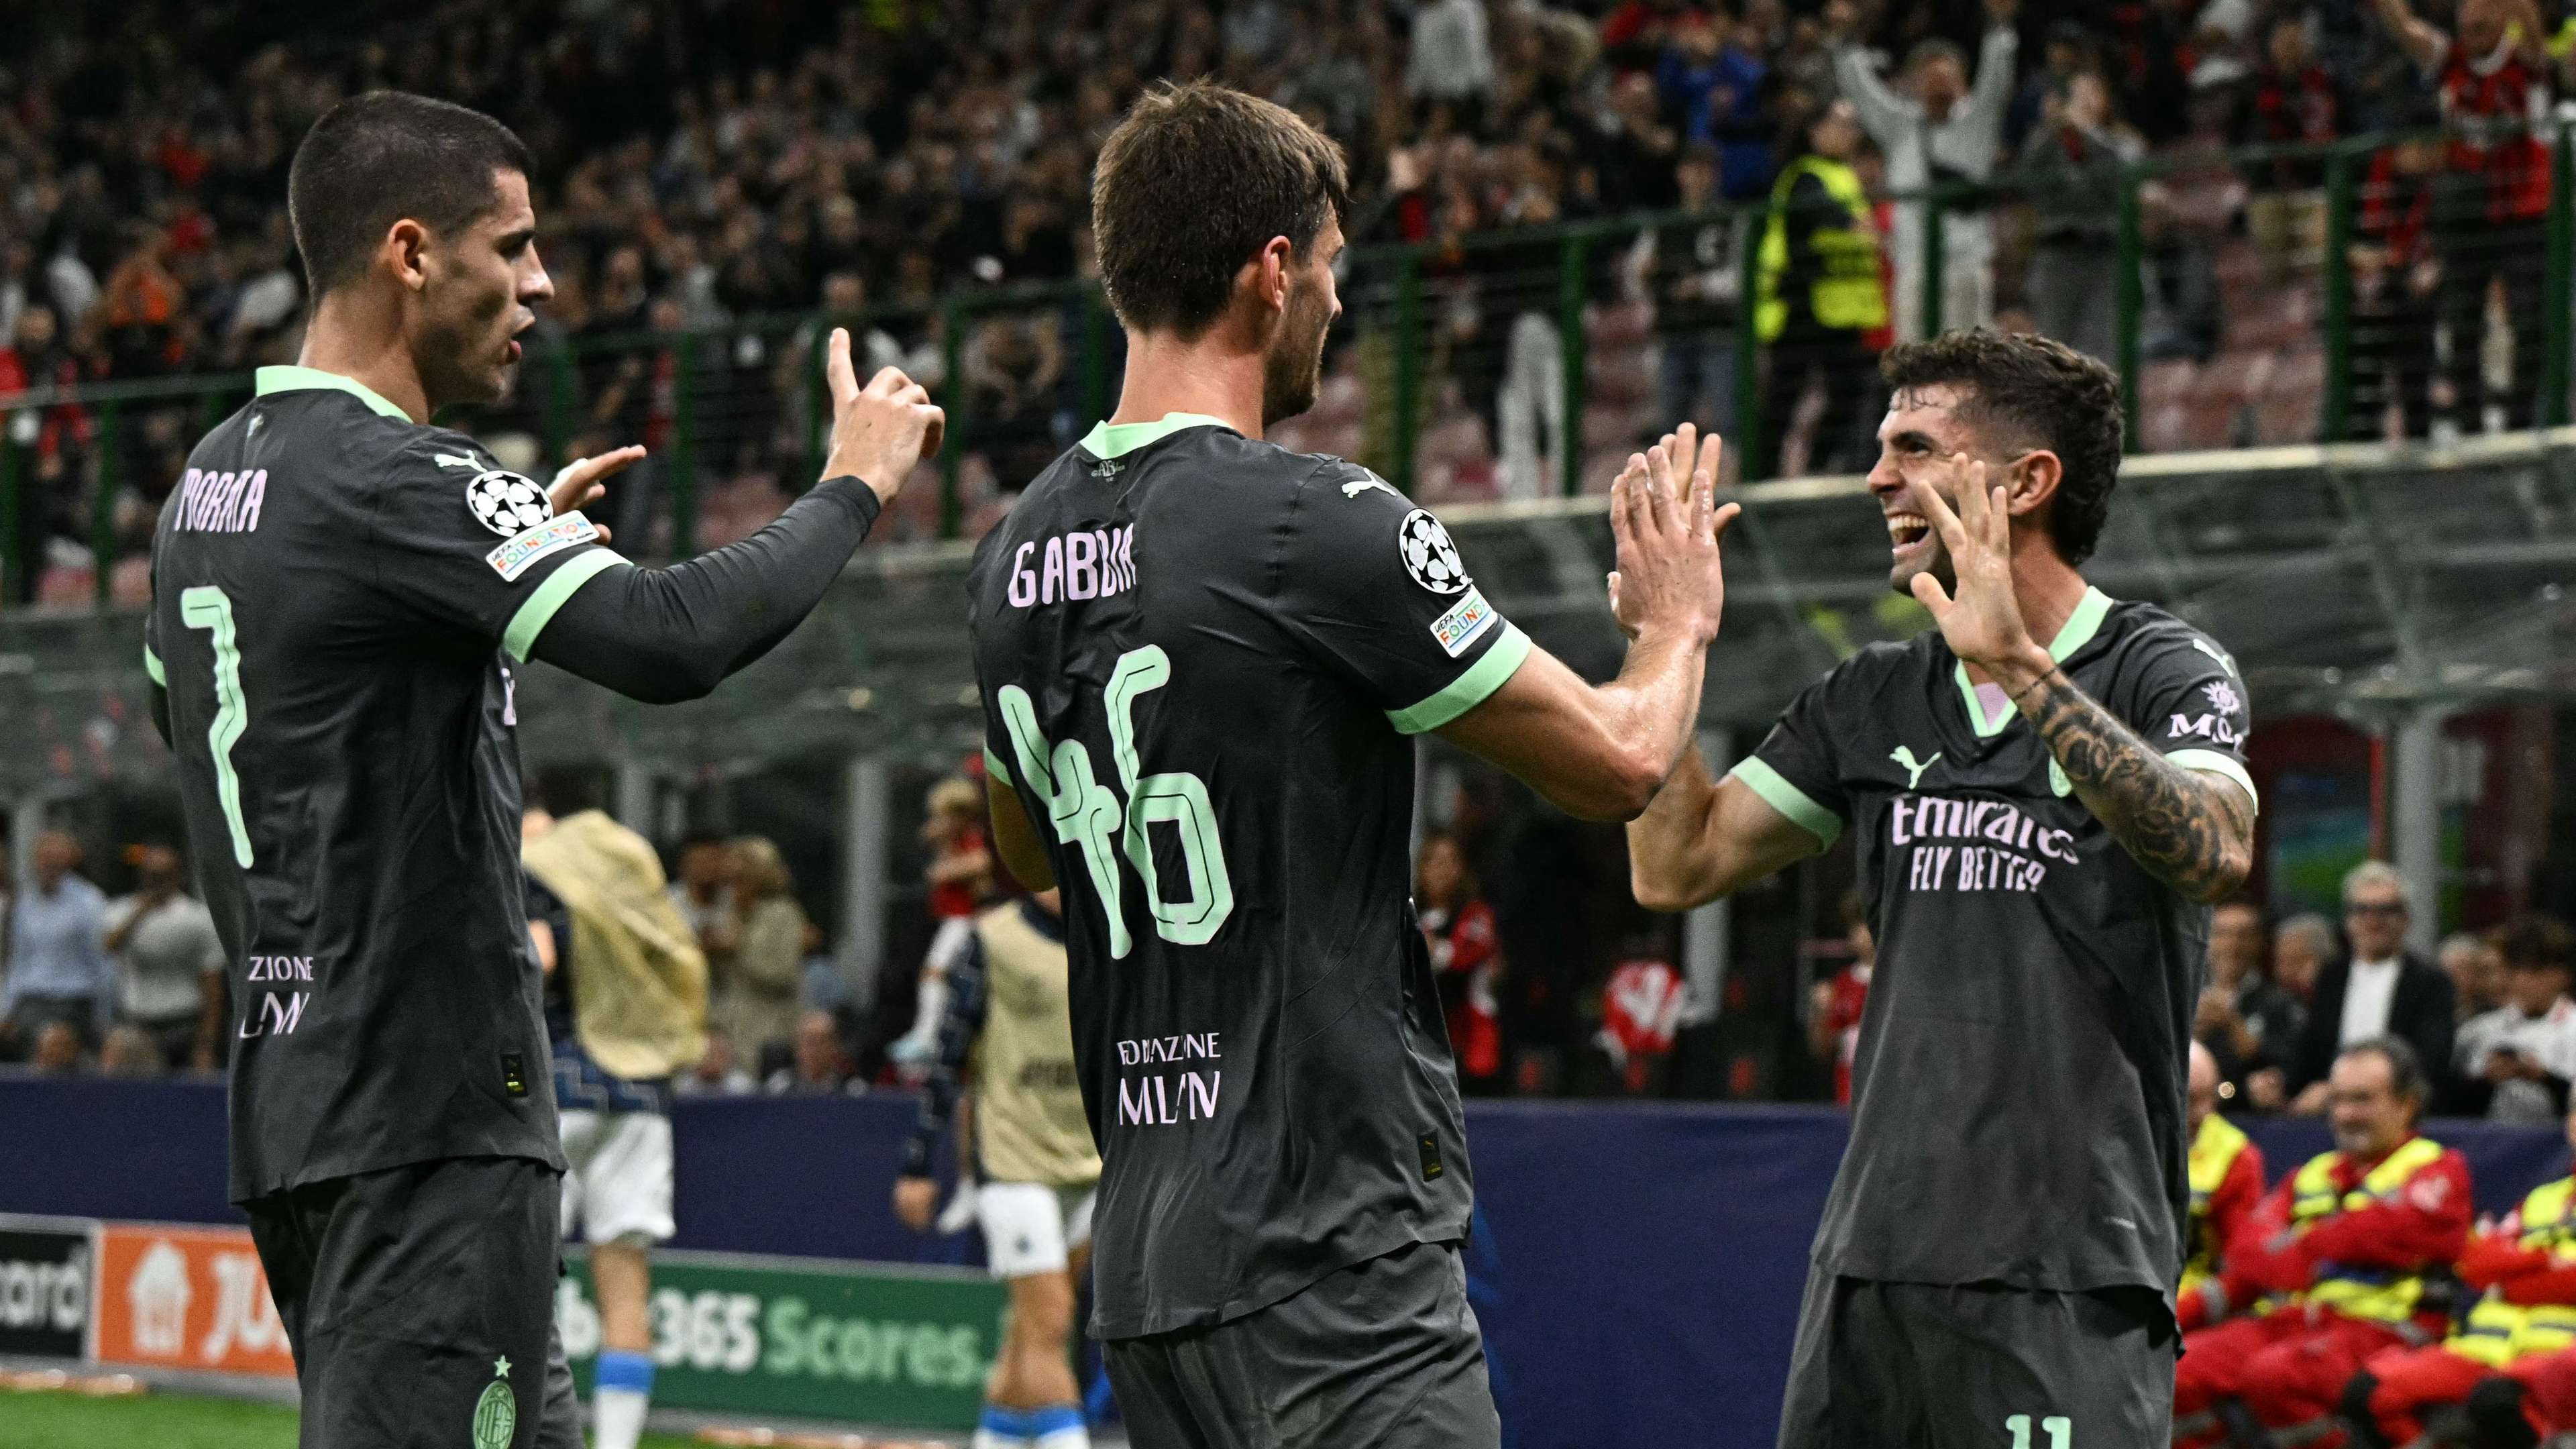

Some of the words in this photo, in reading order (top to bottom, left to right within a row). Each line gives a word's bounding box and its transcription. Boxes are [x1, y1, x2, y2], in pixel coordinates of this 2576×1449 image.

[1008, 523, 1137, 608] GABBIA
[1434, 613, 1454, 633] UEFA
[181, 586, 254, 869] 7
[998, 644, 1234, 960] 46
[1910, 847, 1953, 892] FLY
